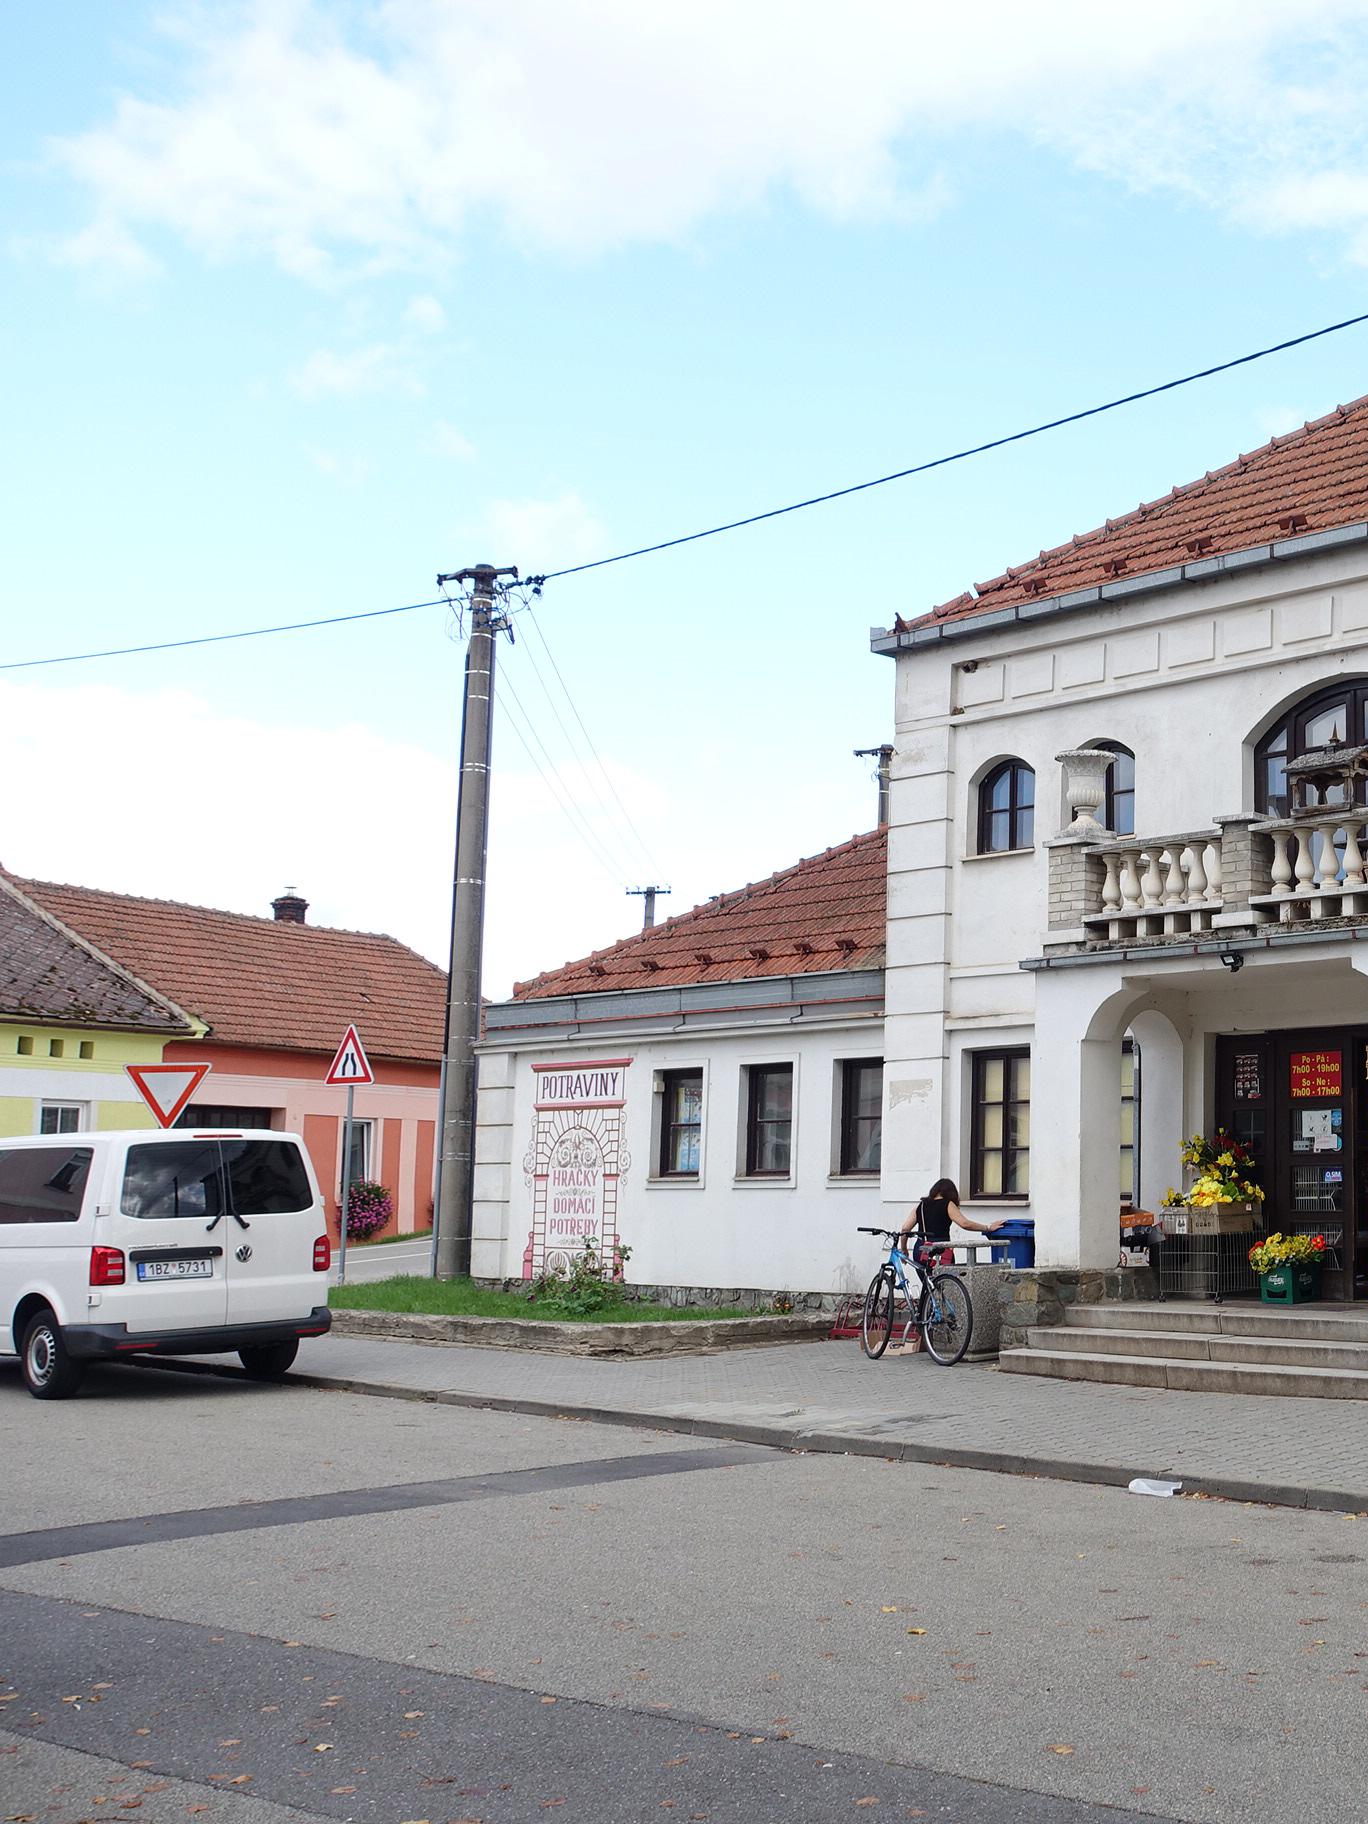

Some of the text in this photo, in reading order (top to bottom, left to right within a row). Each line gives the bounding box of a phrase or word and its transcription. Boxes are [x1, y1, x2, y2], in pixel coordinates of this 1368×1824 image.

[1302, 1056, 1311, 1064] Po
[1316, 1054, 1325, 1063] Pá
[1292, 1066, 1310, 1074] 7h00
[1316, 1064, 1340, 1073] 19h00
[542, 1072, 619, 1100] POTRAVINY
[1302, 1078, 1311, 1086] So
[1316, 1077, 1326, 1086] Ne
[1292, 1088, 1311, 1097] 7h00
[1317, 1086, 1340, 1096] 17h00
[550, 1216, 599, 1236] POTŘEBY
[149, 1261, 206, 1275] 1BZ 5731
